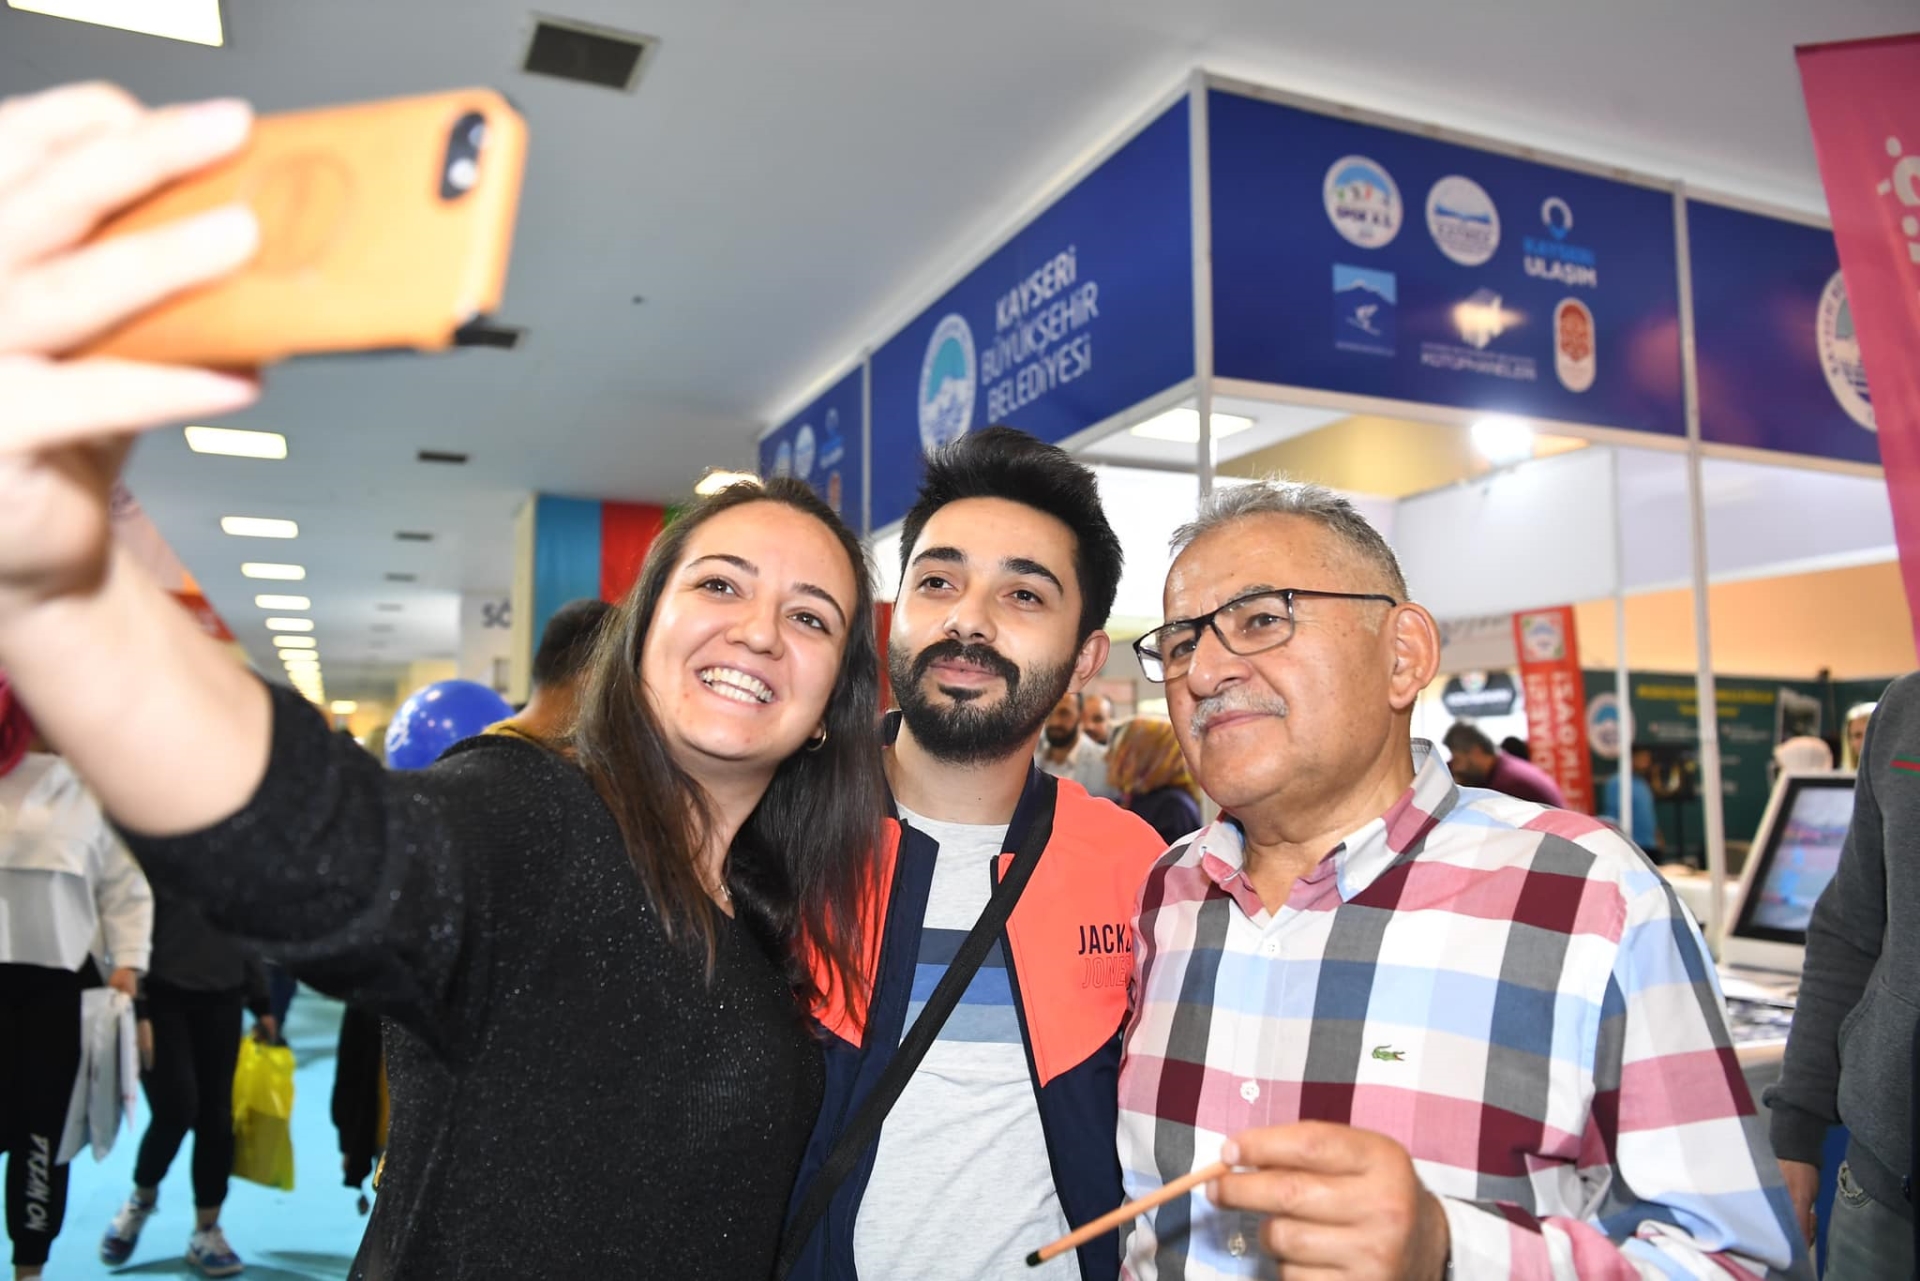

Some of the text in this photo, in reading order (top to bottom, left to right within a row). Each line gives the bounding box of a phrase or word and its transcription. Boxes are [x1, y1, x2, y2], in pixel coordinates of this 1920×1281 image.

[995, 243, 1077, 332] KAYSERİ
[1523, 255, 1597, 288] ULAŞIM
[980, 281, 1100, 386] BÜYÜKŞEHİR
[987, 332, 1093, 424] BELEDİYESİ
